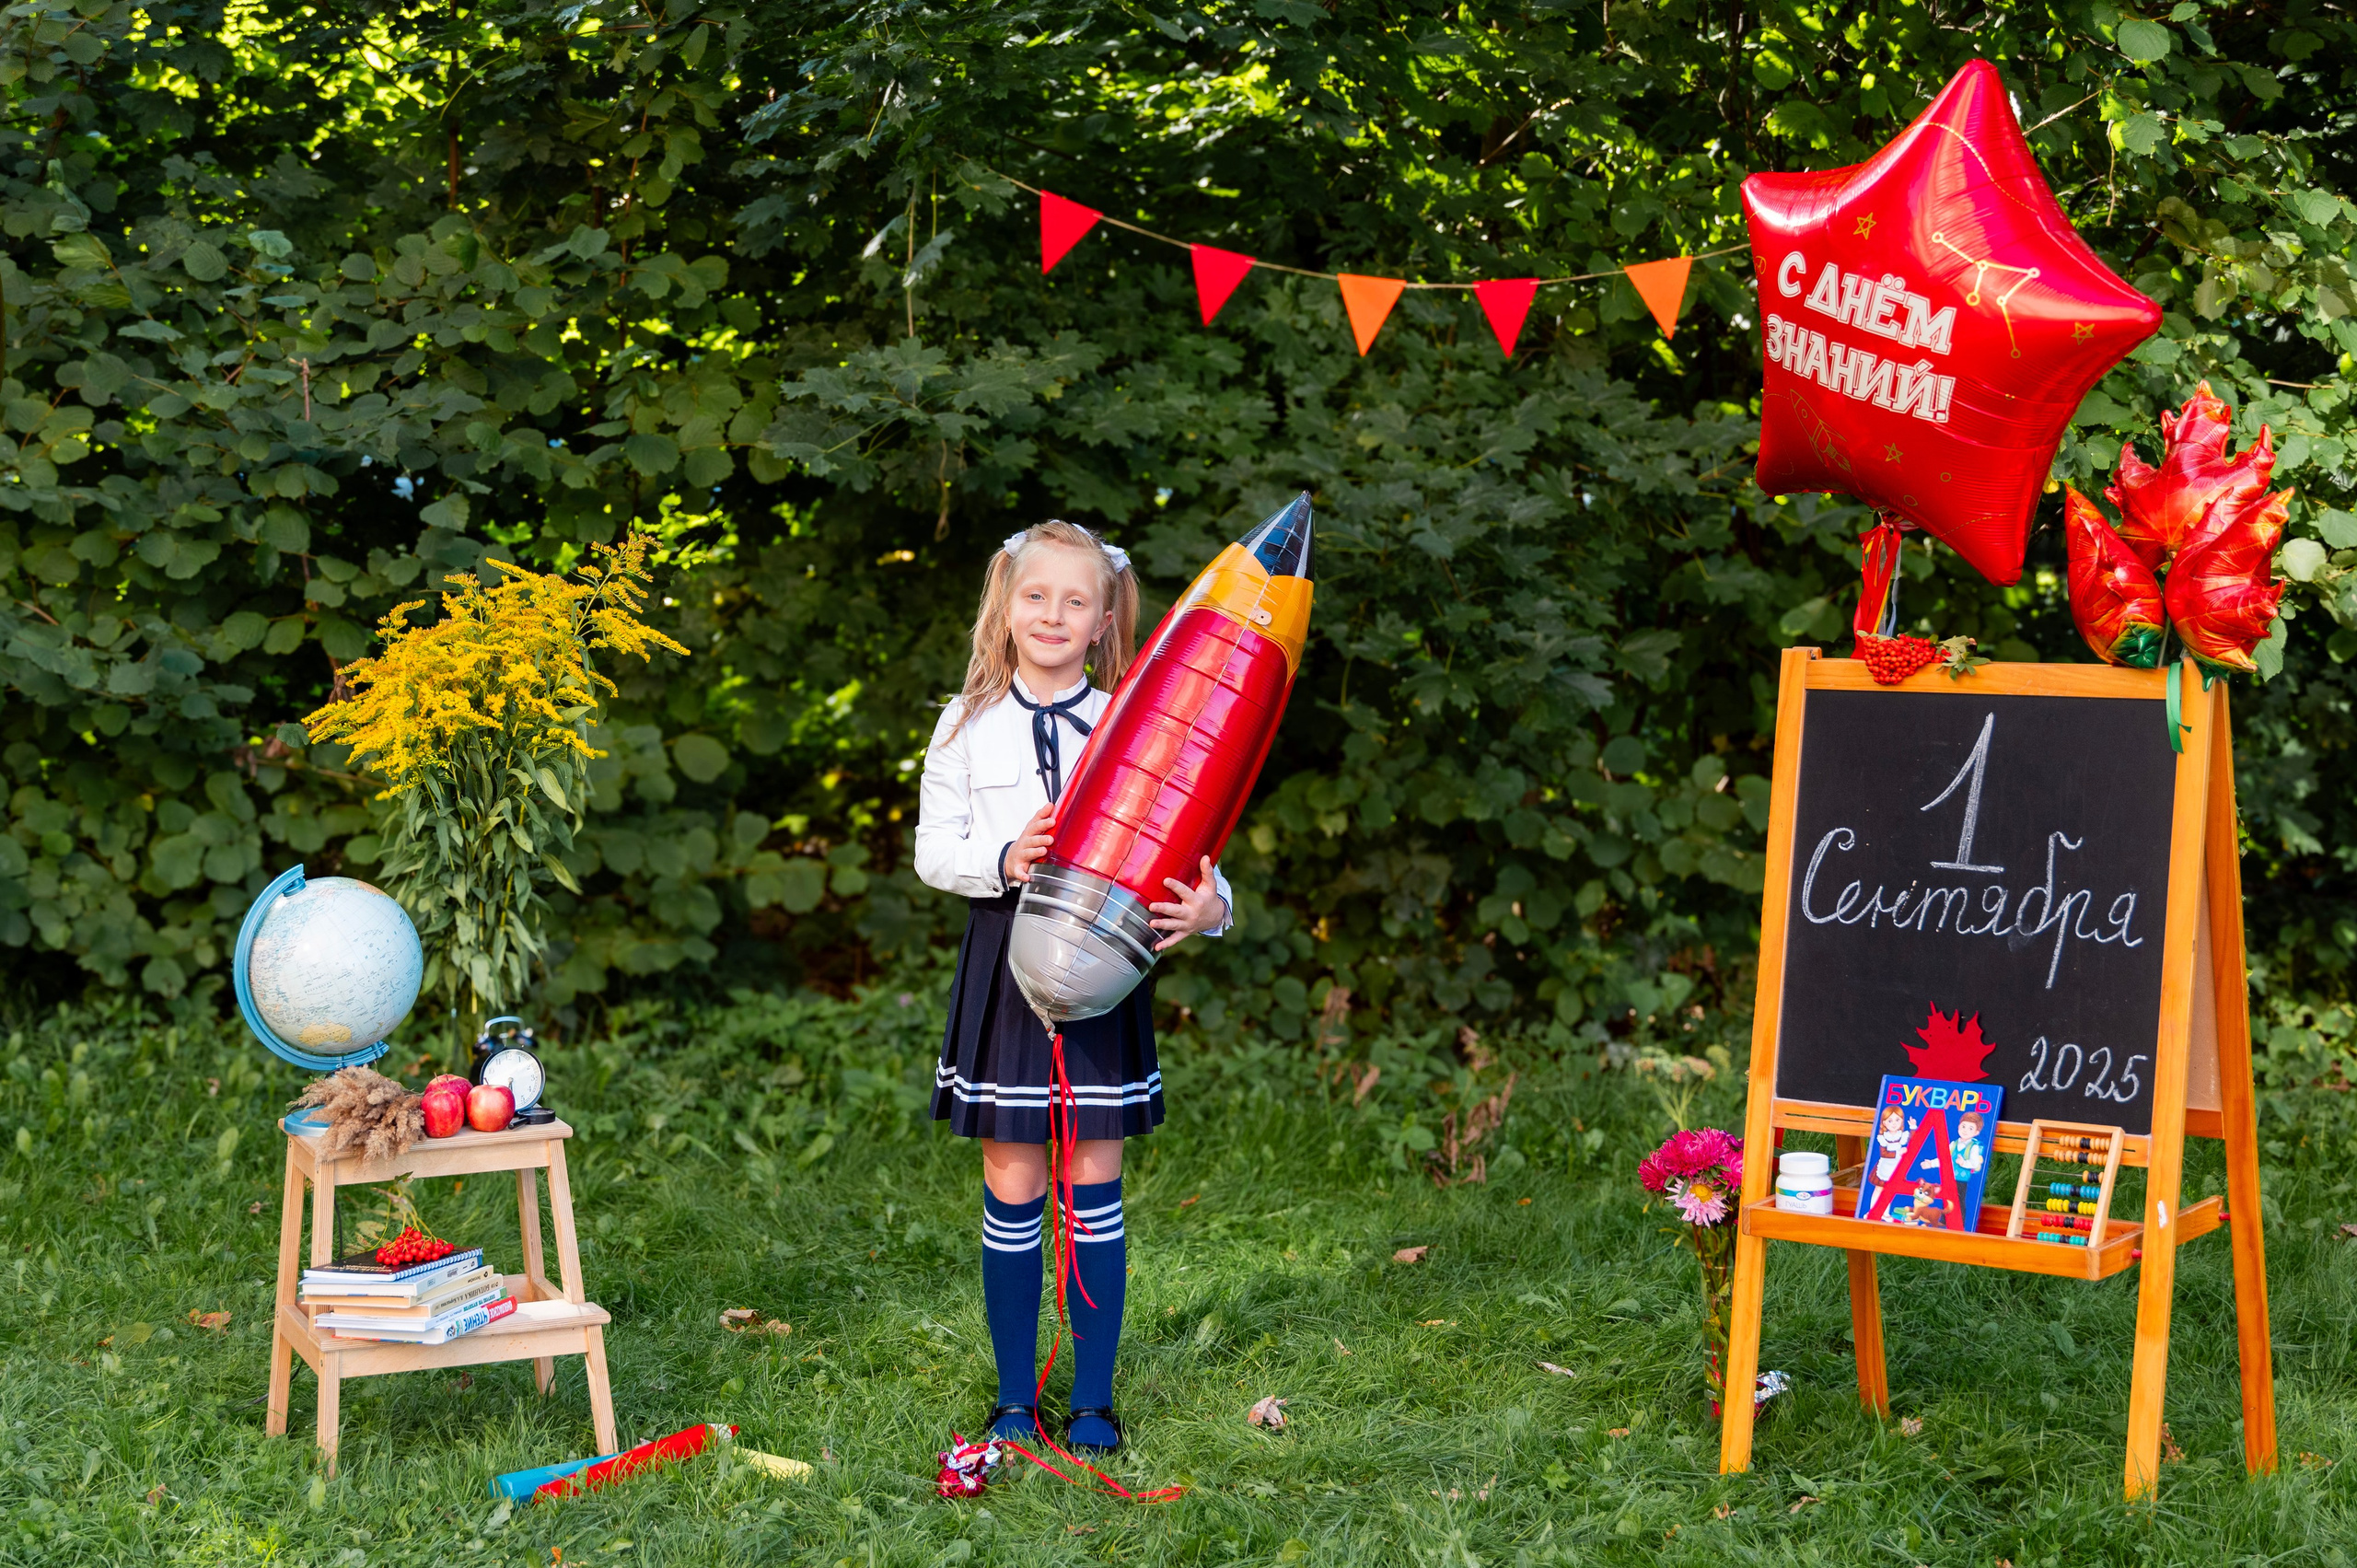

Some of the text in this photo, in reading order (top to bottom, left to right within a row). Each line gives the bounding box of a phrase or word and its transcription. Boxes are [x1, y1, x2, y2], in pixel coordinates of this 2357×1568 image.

[1777, 250, 1957, 355] С ДНЁМ
[1766, 313, 1956, 424] ЗНАНИЙ!
[1920, 712, 2005, 874] 1
[1801, 827, 2143, 990] Сентября
[1885, 1083, 1992, 1114] БУКВАРЬ
[2017, 1036, 2149, 1103] 2025
[463, 1310, 489, 1331] ЧТЕНИЕ
[464, 1281, 490, 1300] БОТАНИКА
